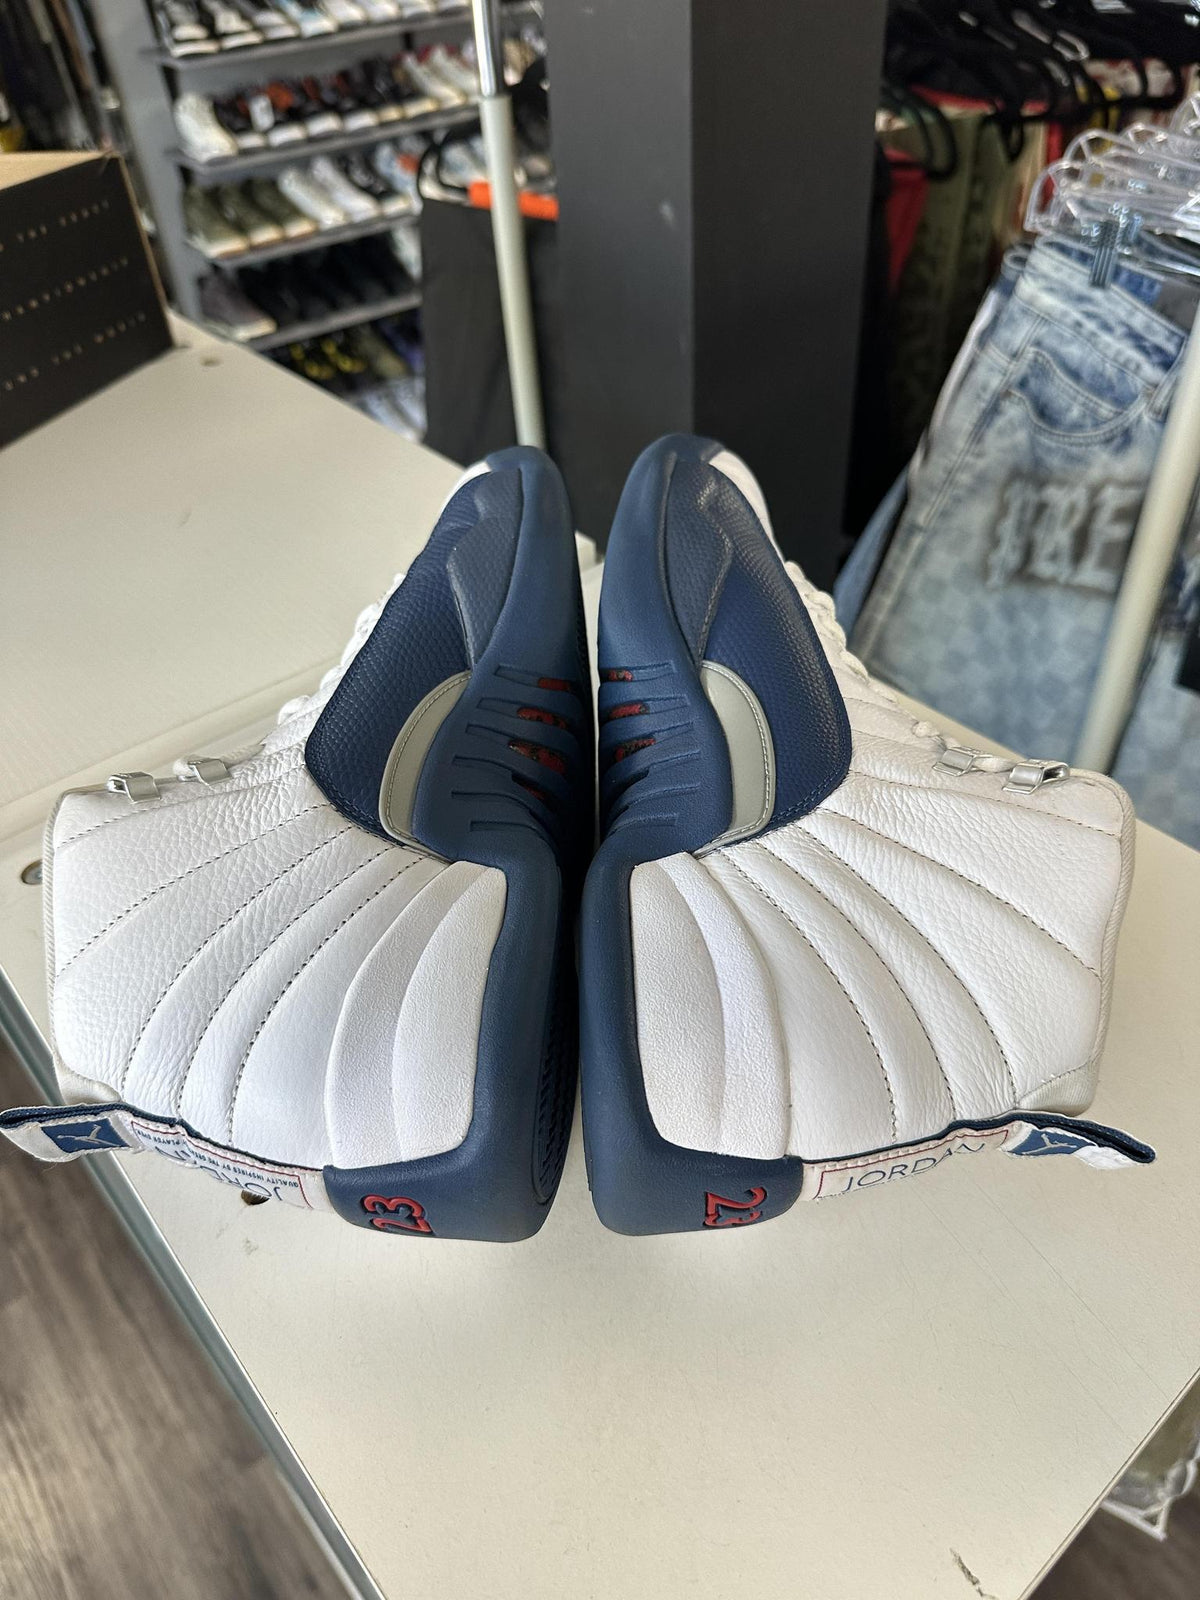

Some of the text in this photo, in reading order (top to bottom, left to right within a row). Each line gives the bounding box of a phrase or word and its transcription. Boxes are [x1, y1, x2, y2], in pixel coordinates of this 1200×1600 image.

[137, 1129, 152, 1140] EVER
[154, 1134, 181, 1146] PLAYER
[208, 1158, 221, 1167] THE
[222, 1163, 232, 1173] BY
[843, 1142, 985, 1192] JORDAN
[155, 1146, 283, 1201] JORDN
[232, 1167, 265, 1181] INSPIRED
[266, 1174, 299, 1188] QUALITY
[361, 1194, 432, 1233] 23
[703, 1187, 767, 1226] 23
